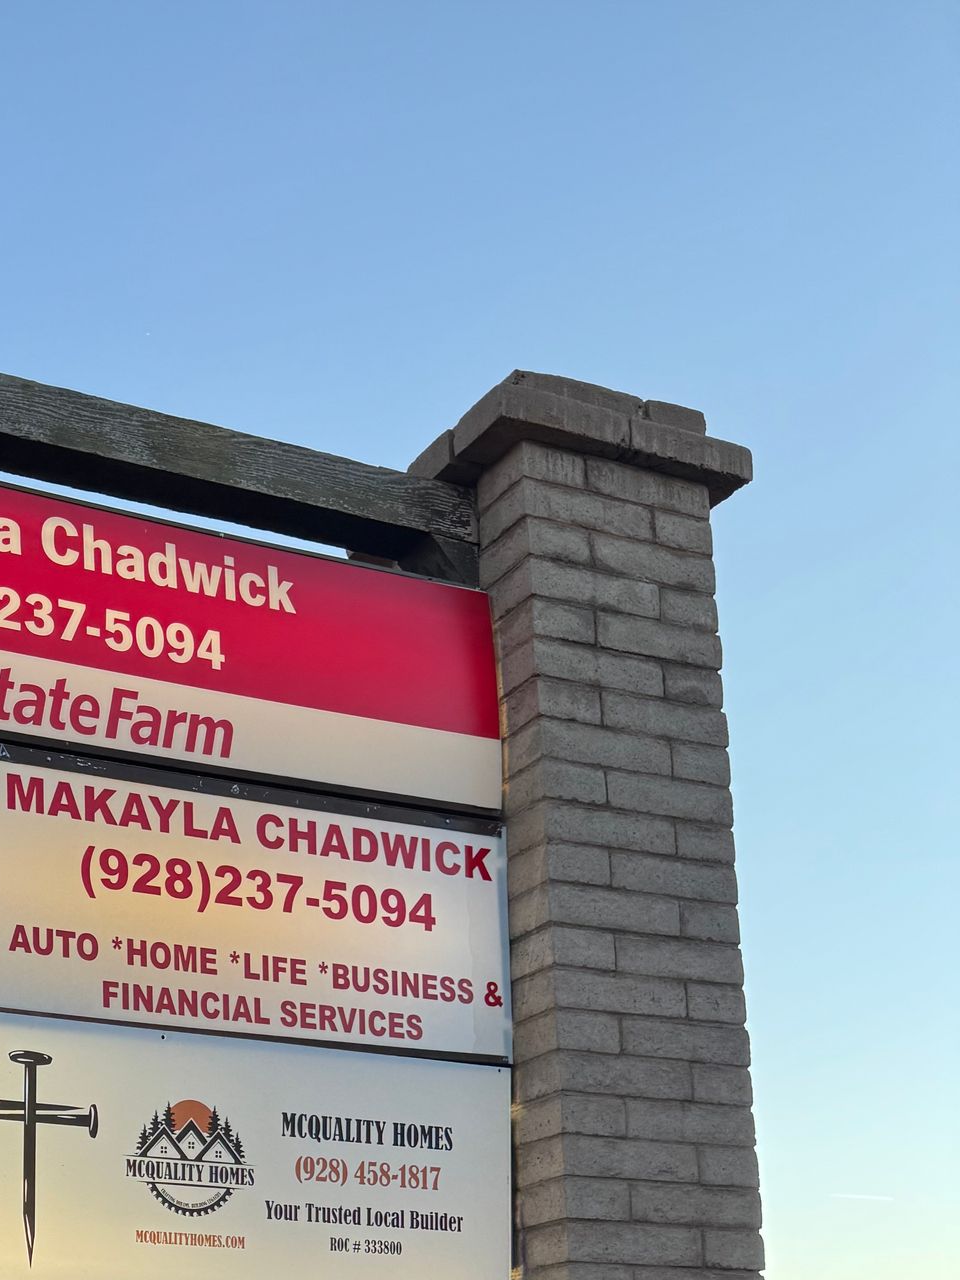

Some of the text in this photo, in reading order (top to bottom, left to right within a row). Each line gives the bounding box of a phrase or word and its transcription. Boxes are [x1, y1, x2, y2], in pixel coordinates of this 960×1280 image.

[41, 516, 296, 614] Chadwick
[6, 773, 492, 881] MAKAYLA CHADWICK
[81, 845, 436, 931] (928)237-5094
[9, 924, 98, 960] AUTO
[484, 981, 503, 1007] &
[103, 980, 423, 1040] FINANCIAL SERVICES
[281, 1112, 454, 1151] MCQUALITY HOMES
[126, 1159, 255, 1186] MCQUALITY HOMES
[295, 1156, 441, 1190] (928) 458-1817
[265, 1200, 464, 1232] Your Trusted Local Builder
[136, 1230, 245, 1249] MCQUALITYHOMES.COM
[329, 1237, 402, 1255] ROC # 333800
